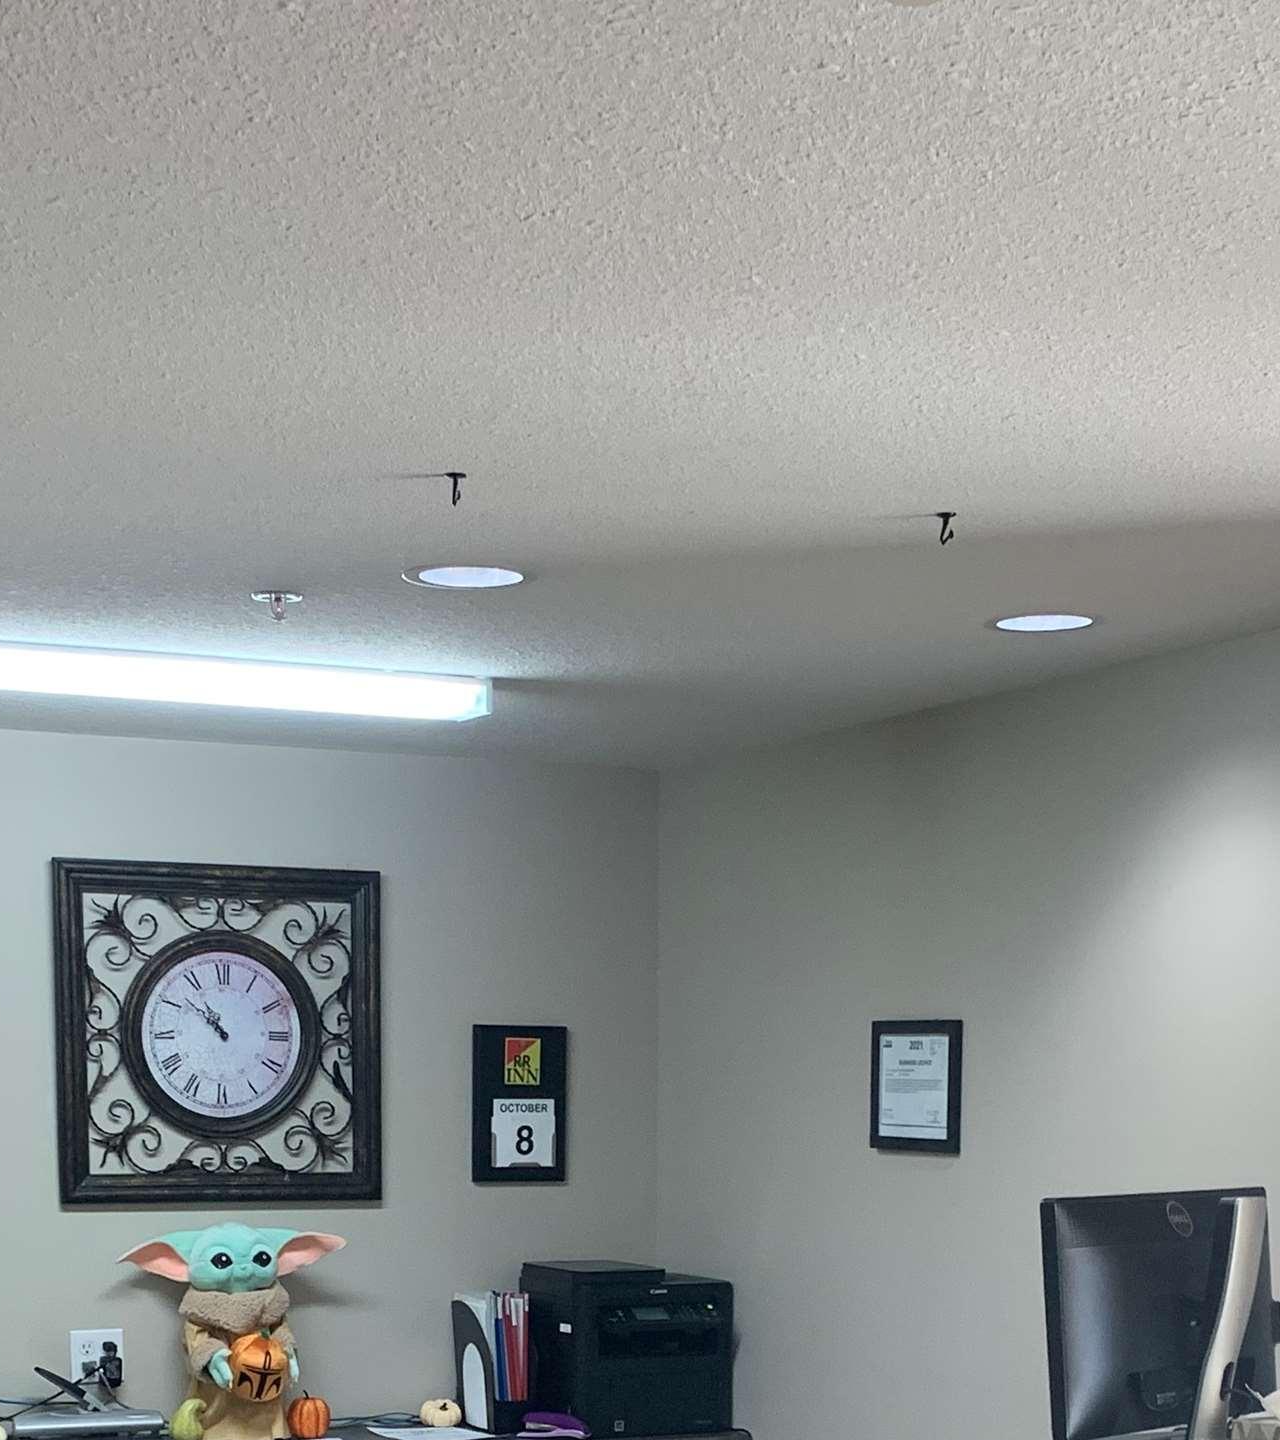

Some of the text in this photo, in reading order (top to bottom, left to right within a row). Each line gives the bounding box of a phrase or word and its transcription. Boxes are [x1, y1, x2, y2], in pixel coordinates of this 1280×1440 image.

[513, 1054, 531, 1068] RR
[506, 1068, 538, 1083] INN
[499, 1103, 548, 1113] OCTOBER
[515, 1125, 534, 1155] 8
